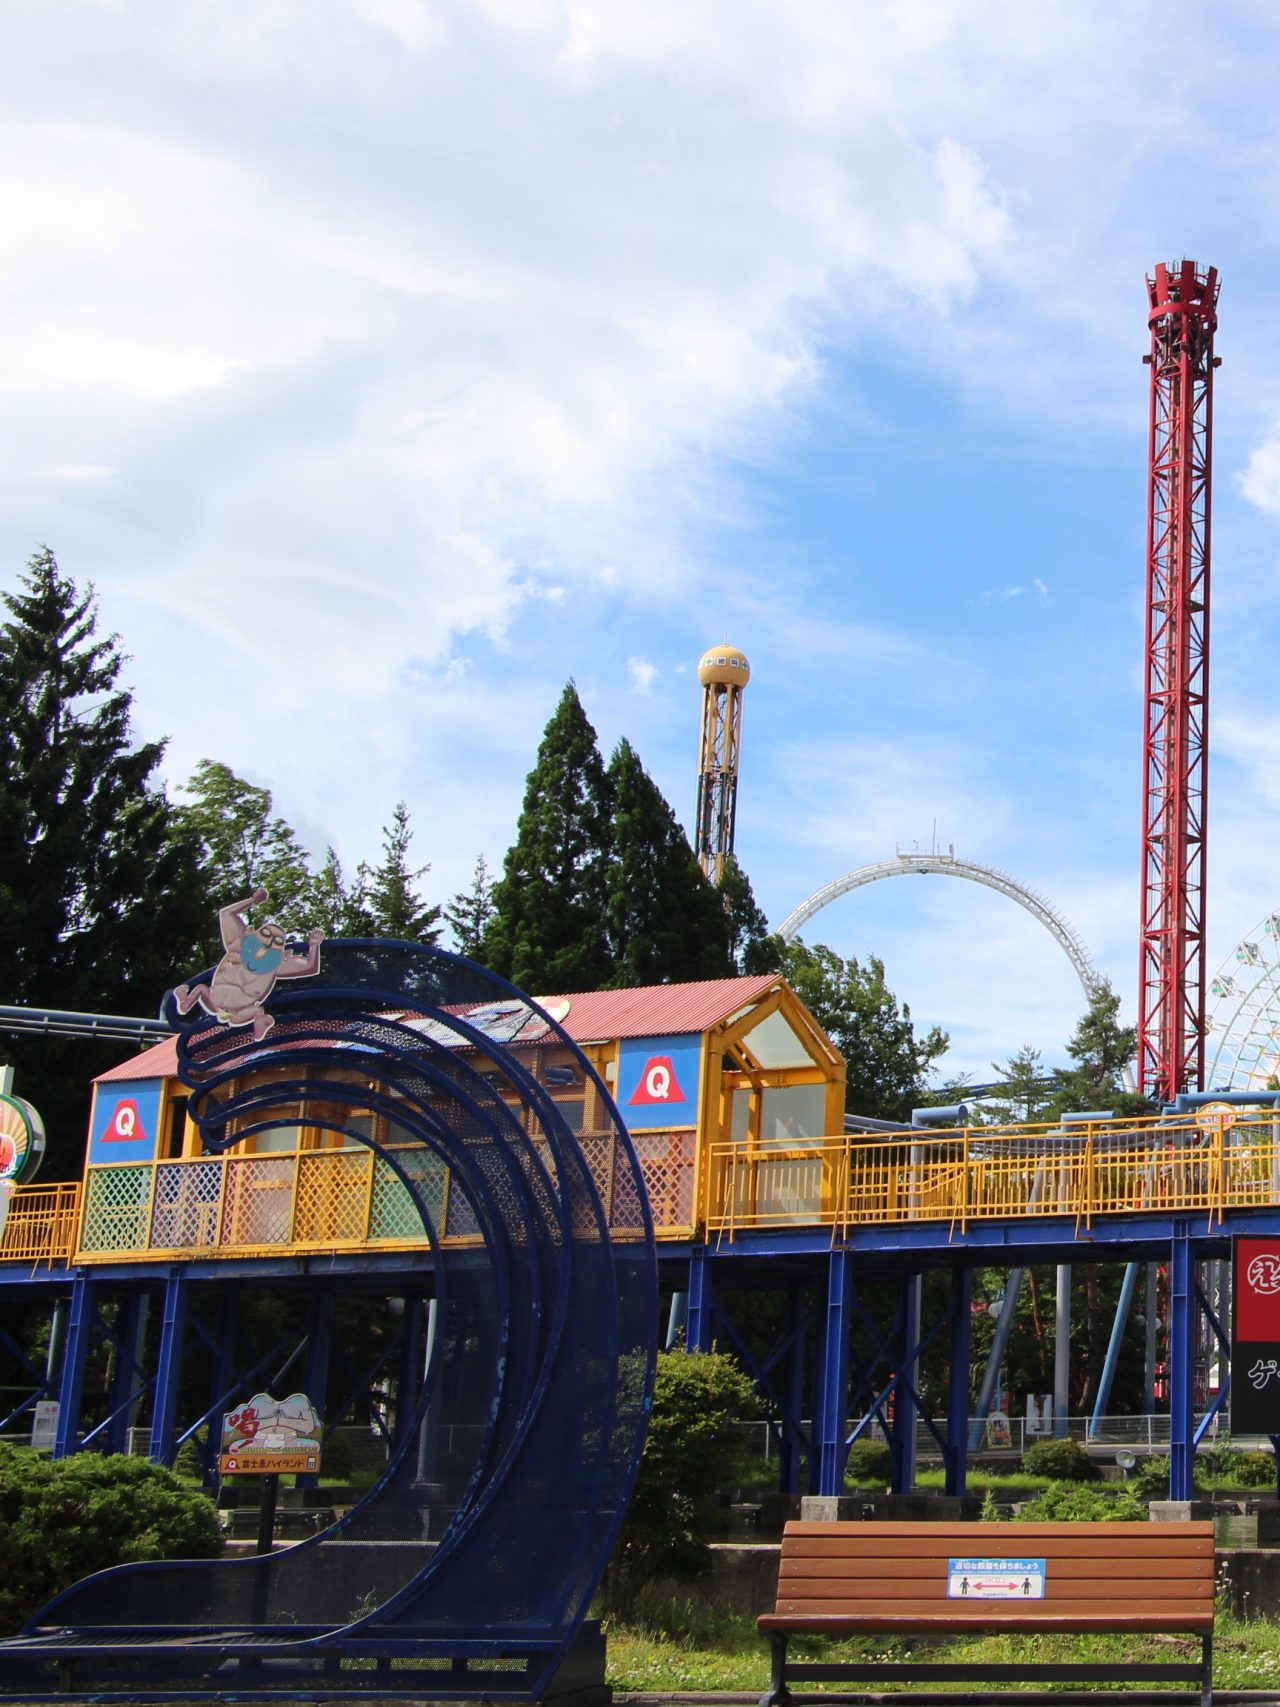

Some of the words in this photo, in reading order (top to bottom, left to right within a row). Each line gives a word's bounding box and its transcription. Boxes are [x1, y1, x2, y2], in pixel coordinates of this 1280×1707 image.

[645, 1065, 670, 1099] Q
[116, 1107, 135, 1137] Q
[242, 1458, 305, 1470] 富士急ハイランド
